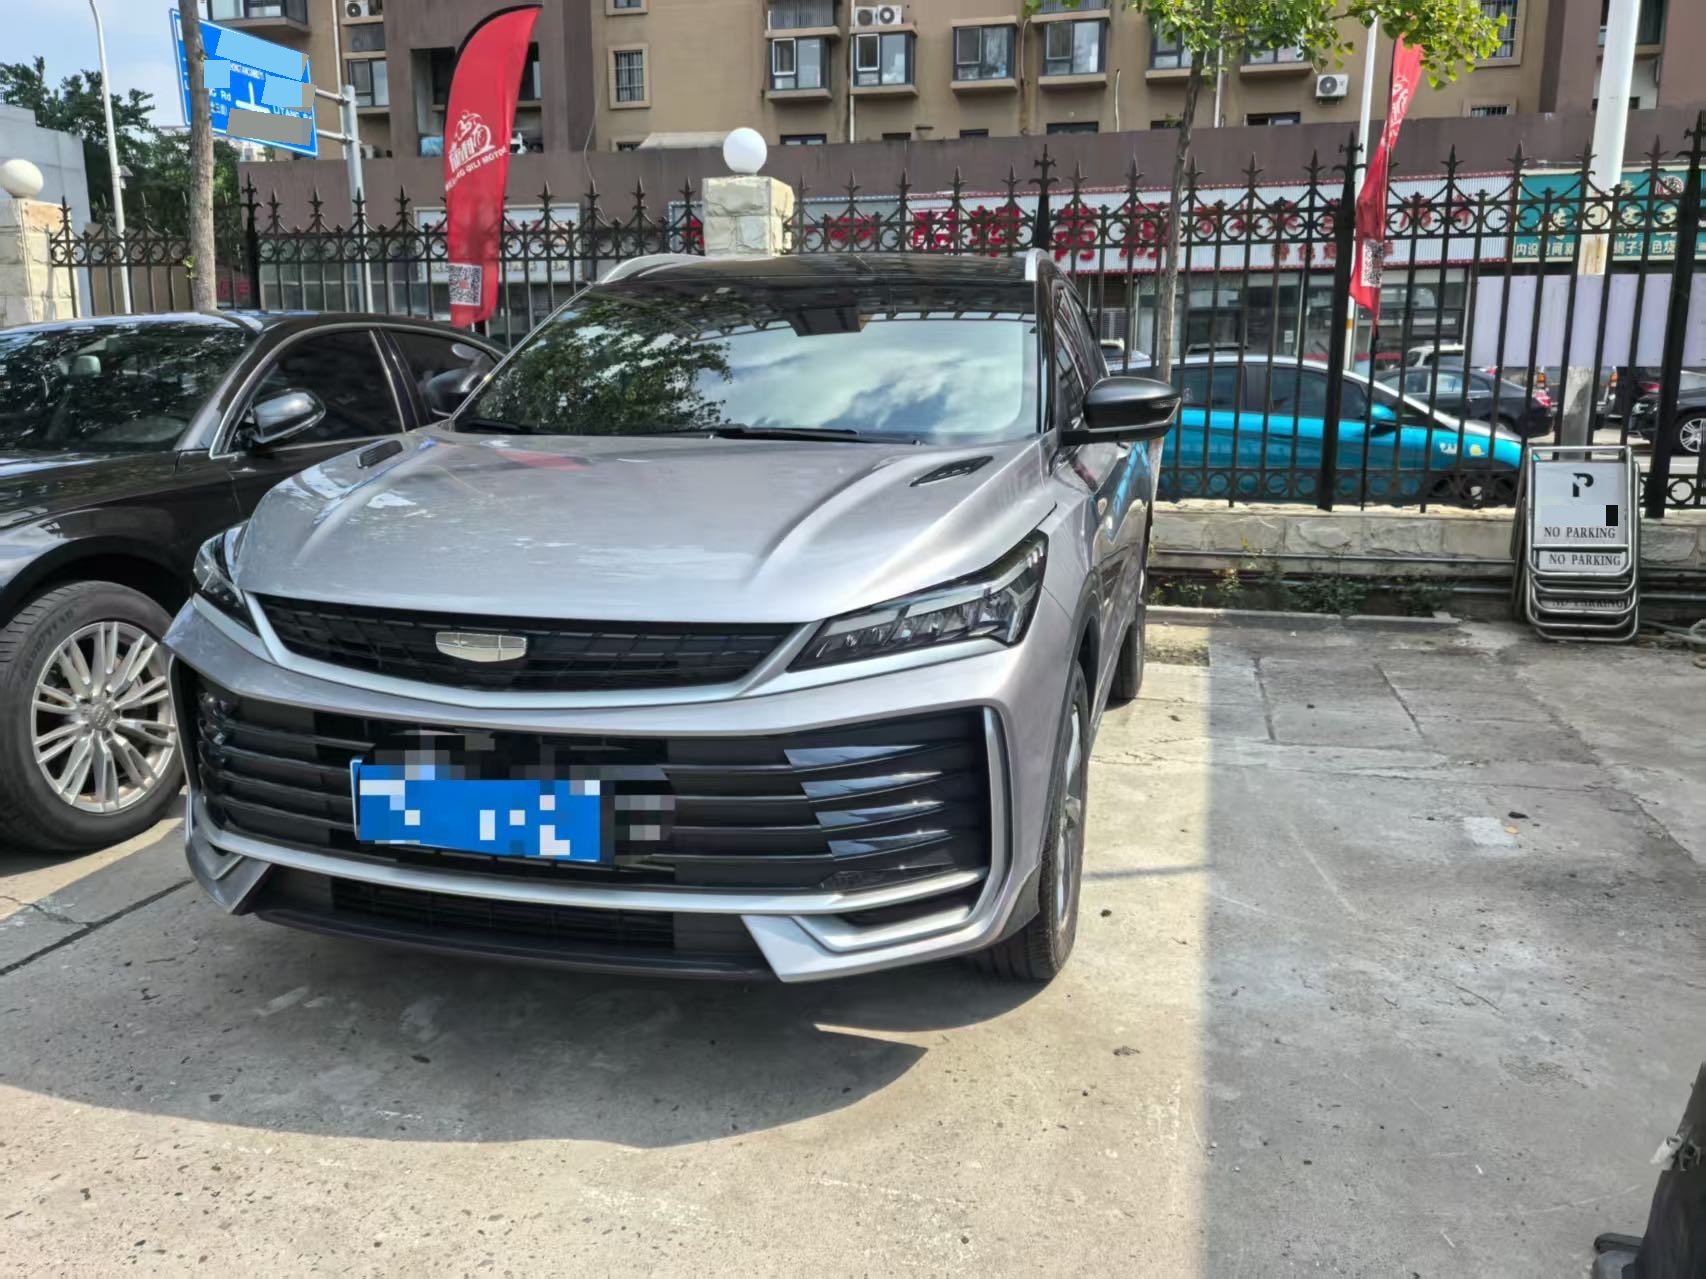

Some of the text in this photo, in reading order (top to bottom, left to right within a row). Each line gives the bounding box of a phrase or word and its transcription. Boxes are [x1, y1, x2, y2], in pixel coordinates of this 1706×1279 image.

[1543, 526, 1616, 539] NO PARKING
[1548, 553, 1621, 567] NO PARKING
